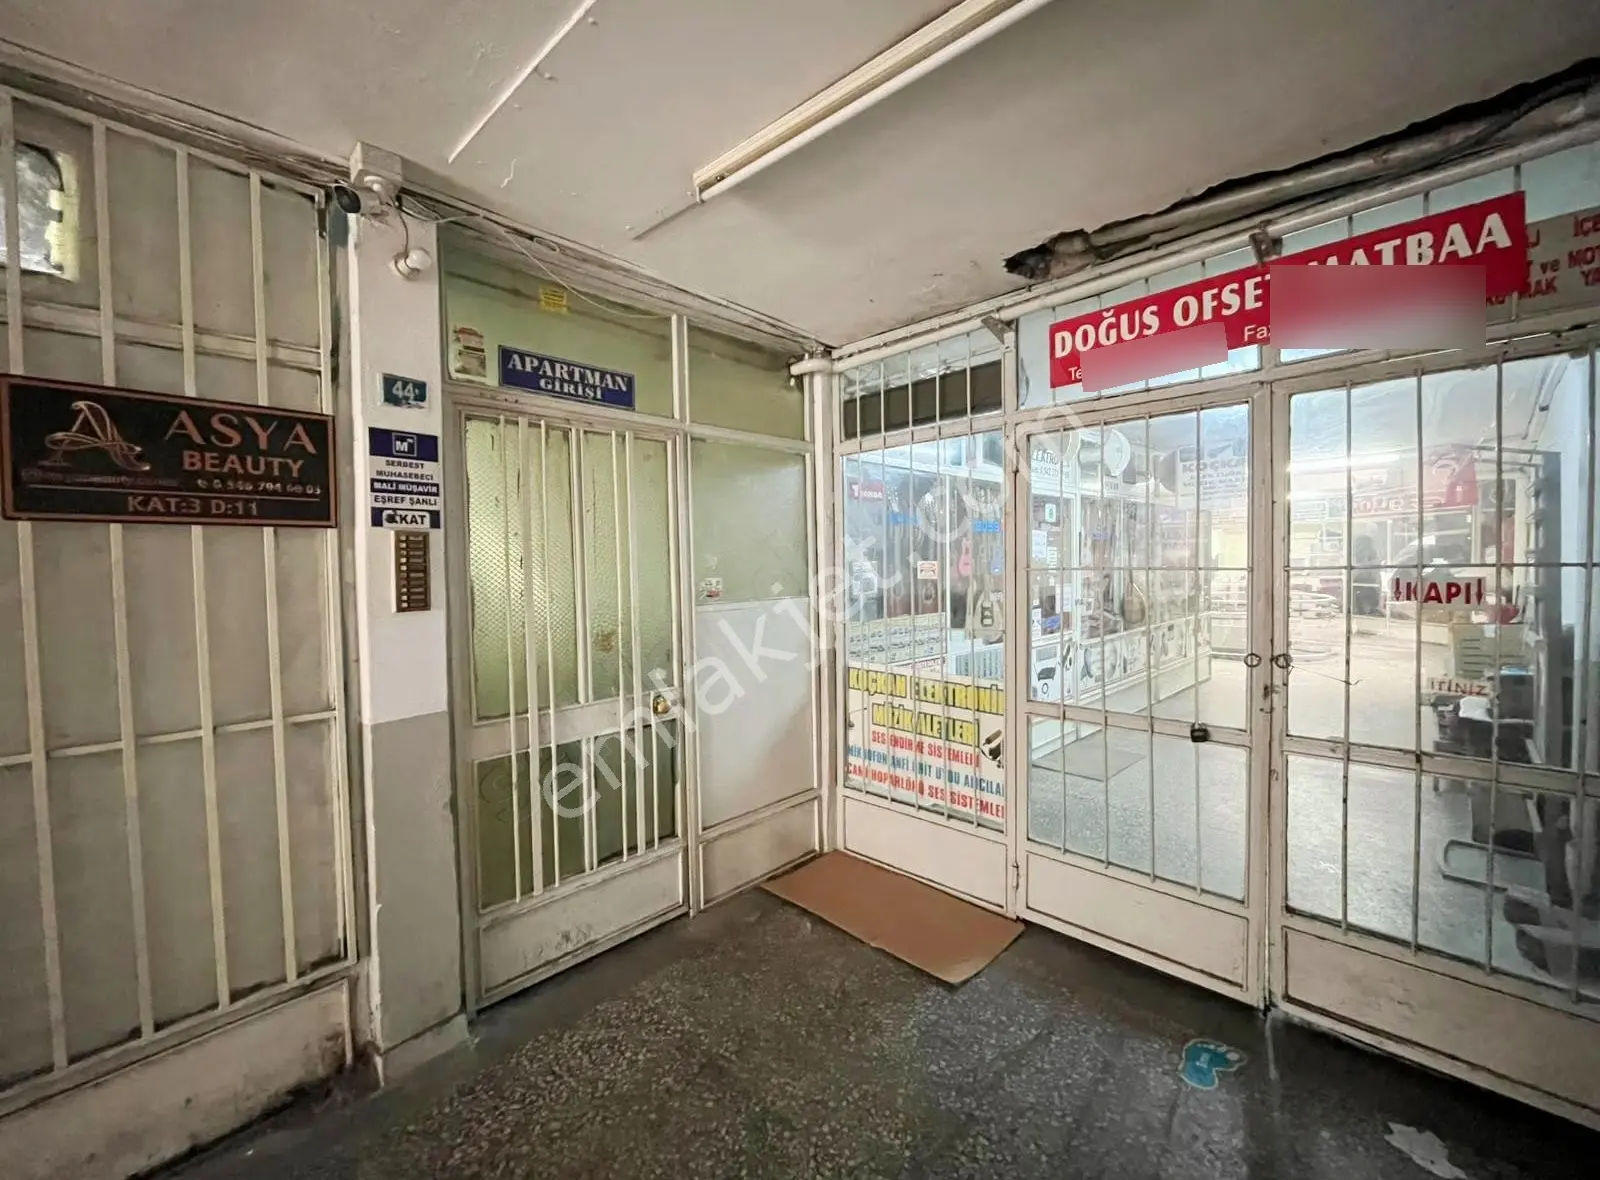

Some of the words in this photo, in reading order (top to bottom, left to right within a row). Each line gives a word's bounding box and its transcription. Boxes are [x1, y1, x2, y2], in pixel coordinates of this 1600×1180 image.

[1172, 274, 1271, 328] OFSE
[508, 354, 628, 392] APARTMAN
[165, 410, 317, 455] ASYA
[183, 450, 304, 478] BEAUTY
[385, 460, 425, 469] SERBEST
[373, 482, 396, 490] MALİ
[128, 496, 201, 514] KAT:3
[211, 499, 258, 516] D:11
[374, 495, 405, 504] EŞREF
[1406, 582, 1472, 605] KAPI
